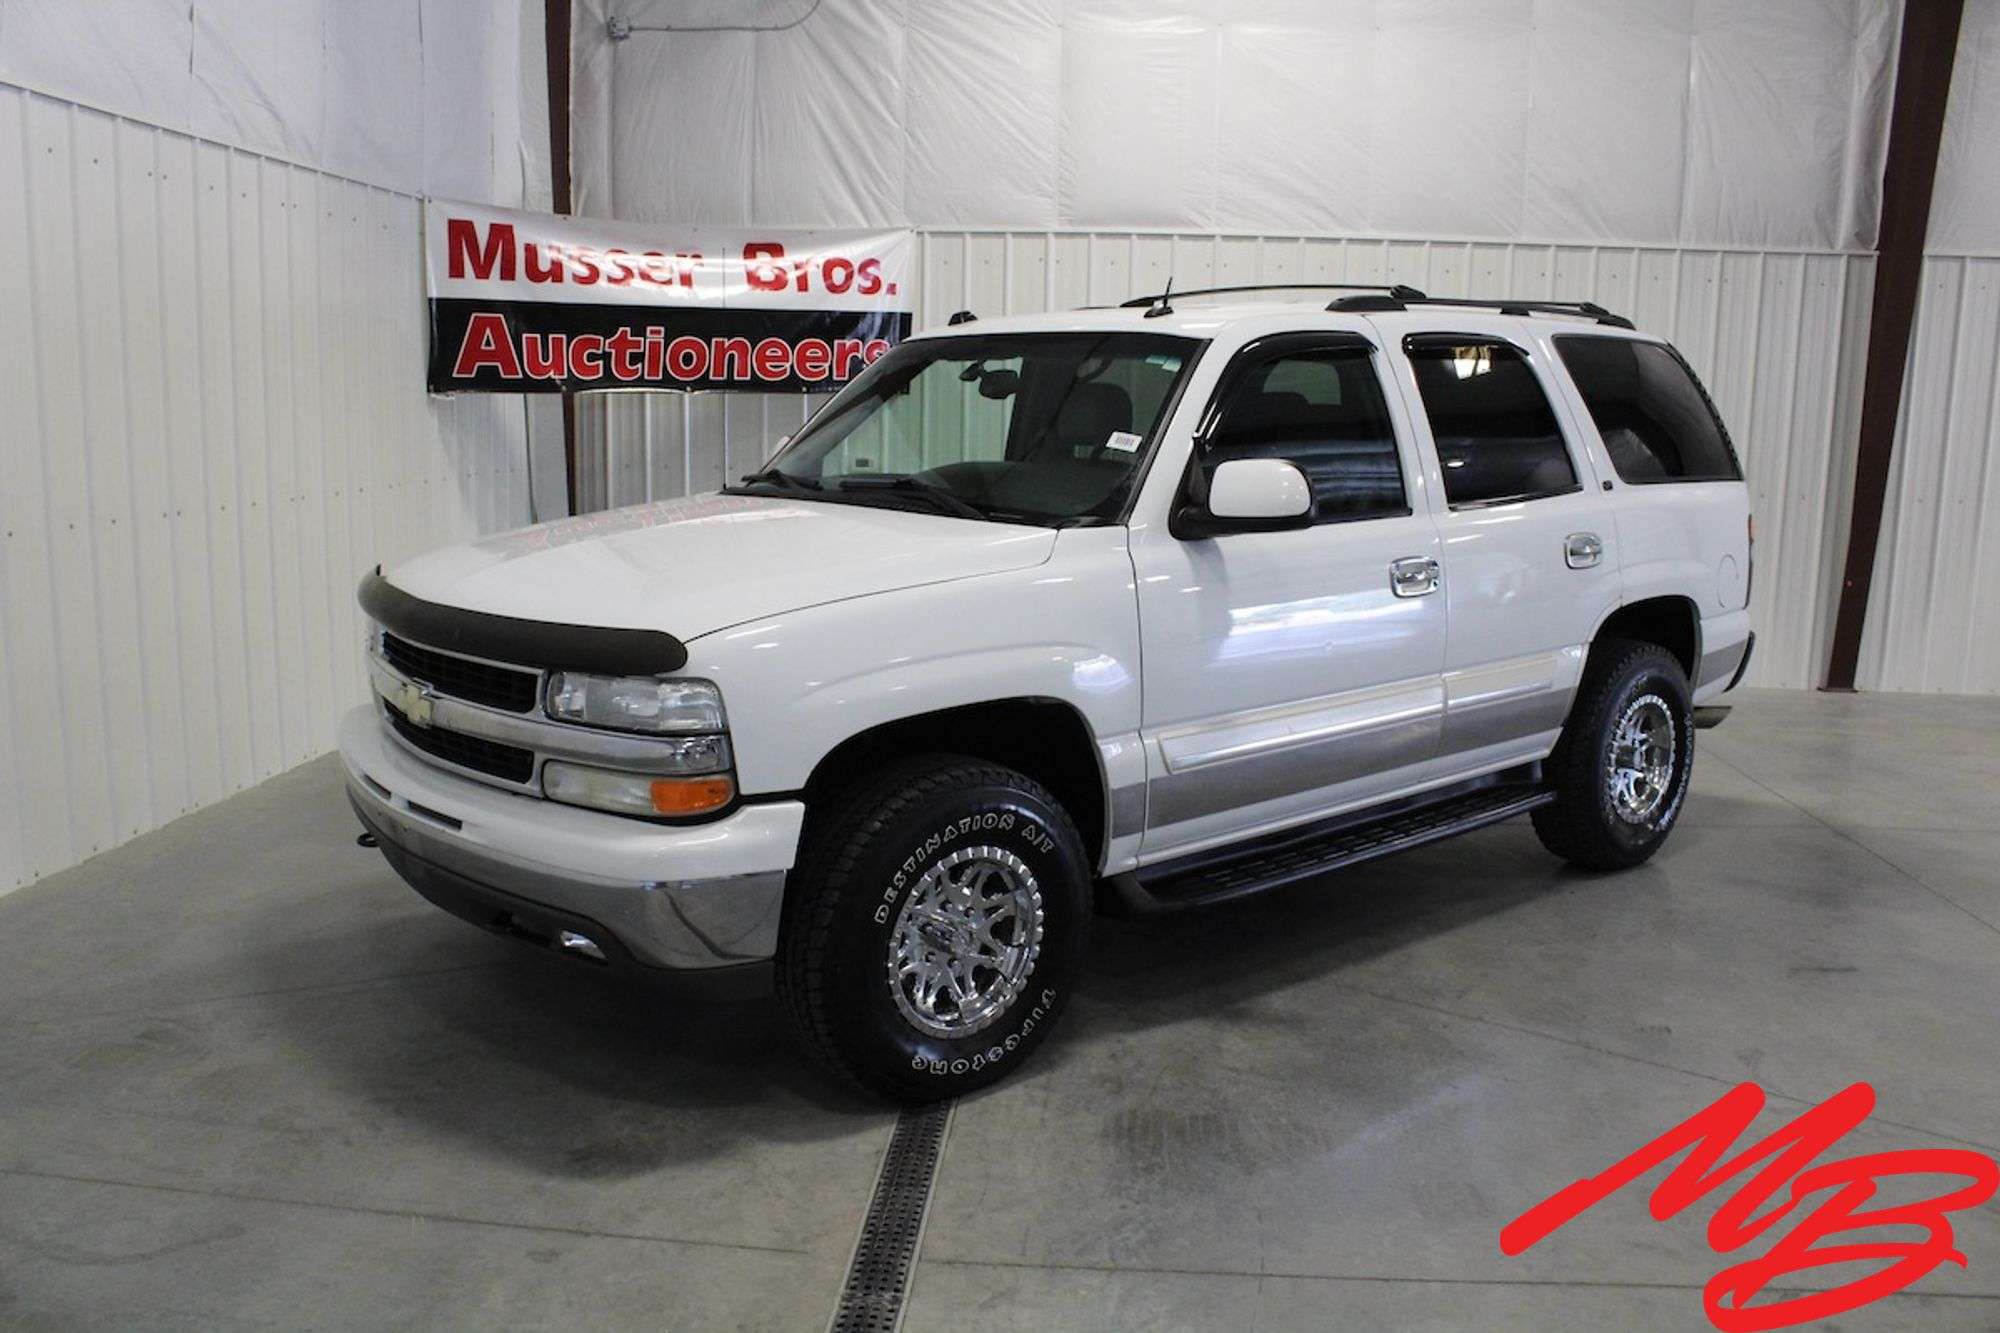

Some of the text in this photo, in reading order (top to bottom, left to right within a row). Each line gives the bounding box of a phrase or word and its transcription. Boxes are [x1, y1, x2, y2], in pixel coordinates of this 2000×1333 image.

[447, 218, 897, 295] Musser Bros.
[875, 813, 1056, 924] DESTINATION A/T
